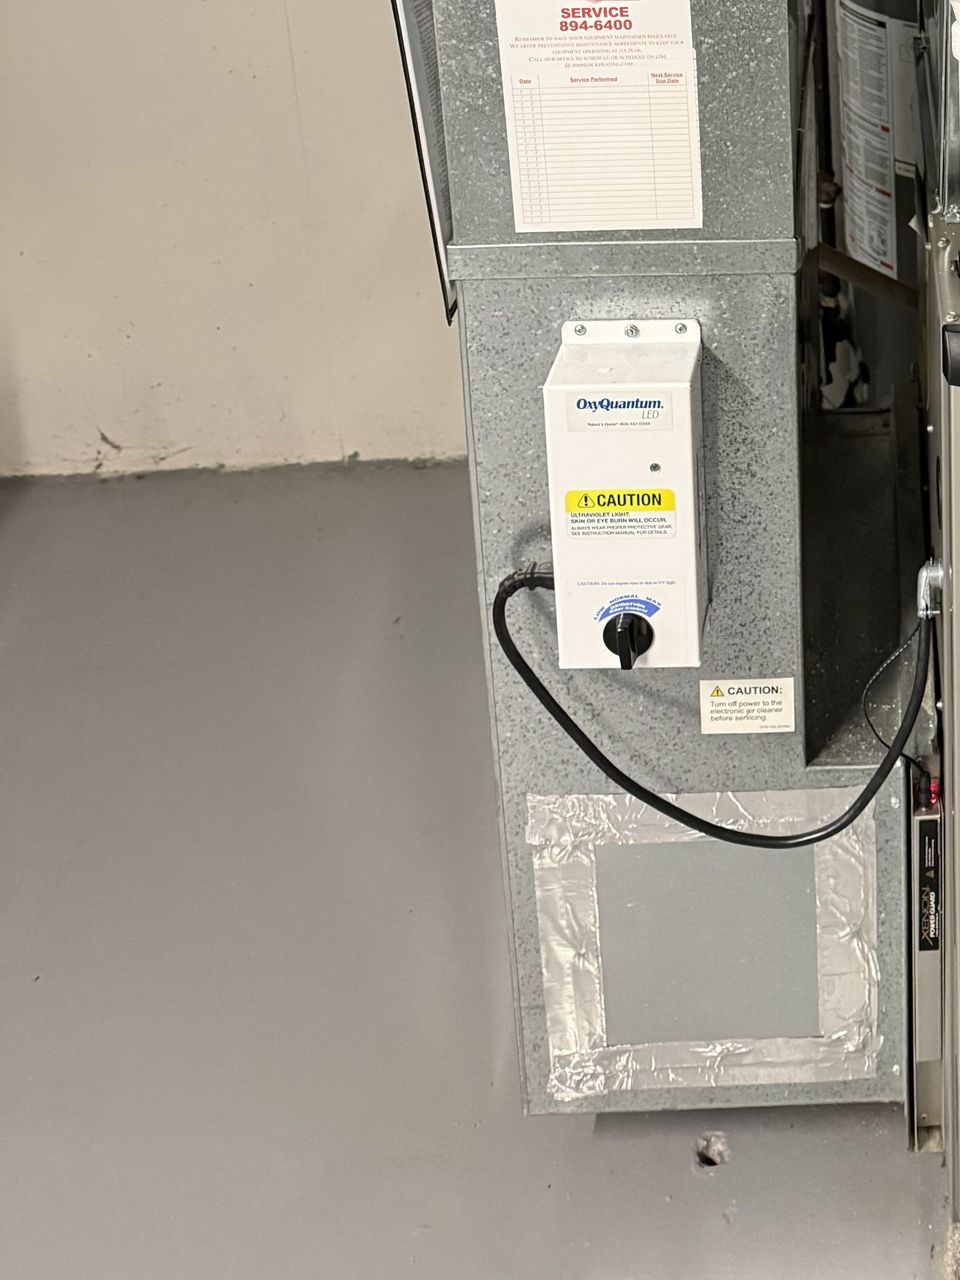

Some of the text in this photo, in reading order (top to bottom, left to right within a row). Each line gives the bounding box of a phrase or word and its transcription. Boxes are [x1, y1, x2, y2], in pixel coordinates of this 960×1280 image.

[561, 7, 629, 18] SERVICE
[560, 19, 632, 31] 894-6400
[642, 410, 660, 419] LED
[597, 493, 662, 507] CAUTION
[727, 686, 783, 696] CAUTION:
[738, 701, 761, 709] power
[735, 714, 766, 722] servicing
